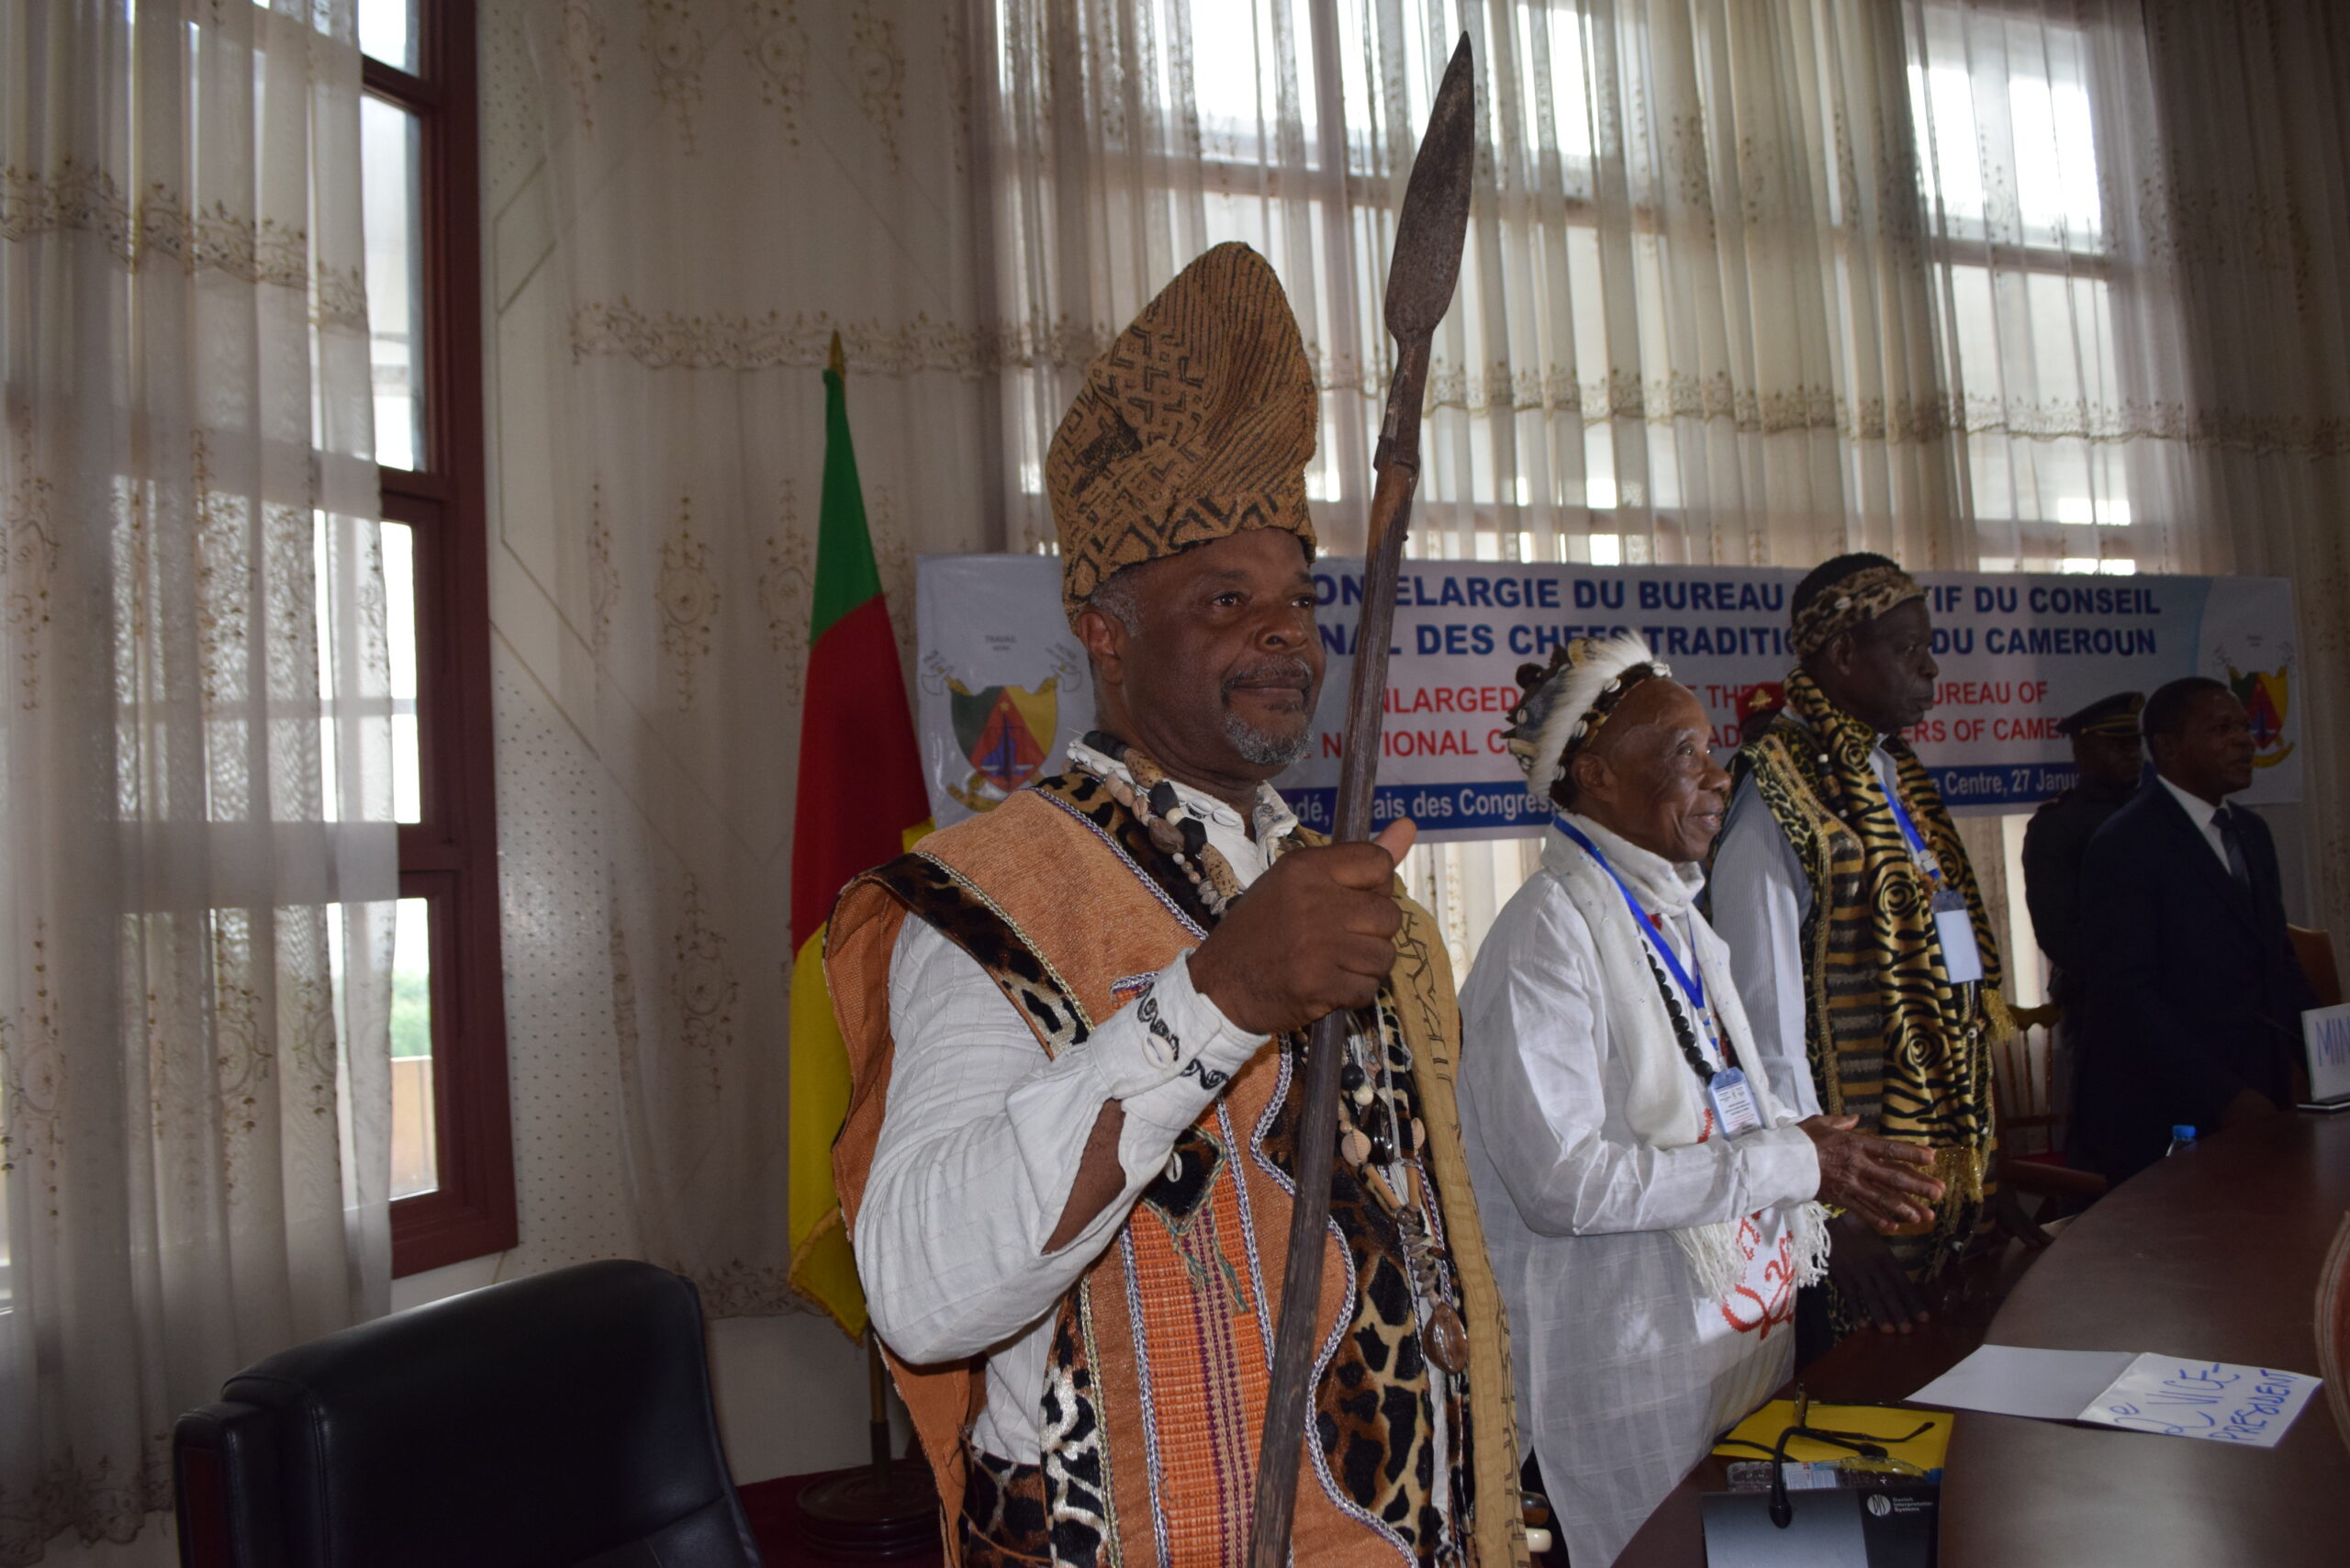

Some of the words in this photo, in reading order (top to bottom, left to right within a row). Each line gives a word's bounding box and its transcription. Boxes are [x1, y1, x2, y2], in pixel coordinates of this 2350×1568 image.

[1394, 575, 1561, 609] ELARGIE
[1573, 579, 1625, 610] DU
[1639, 579, 1784, 611] BUREAU
[1975, 586, 2018, 613] DU
[2029, 587, 2162, 615] CONSEIL
[1416, 623, 1494, 655] DES
[1931, 628, 1974, 655] DU
[1986, 628, 2157, 656] CAMEROUN
[2018, 681, 2048, 704] OF
[1953, 719, 1986, 742] OF
[1413, 790, 1452, 818] des
[1944, 771, 2009, 796] Centre,
[2012, 769, 2030, 793] 27
